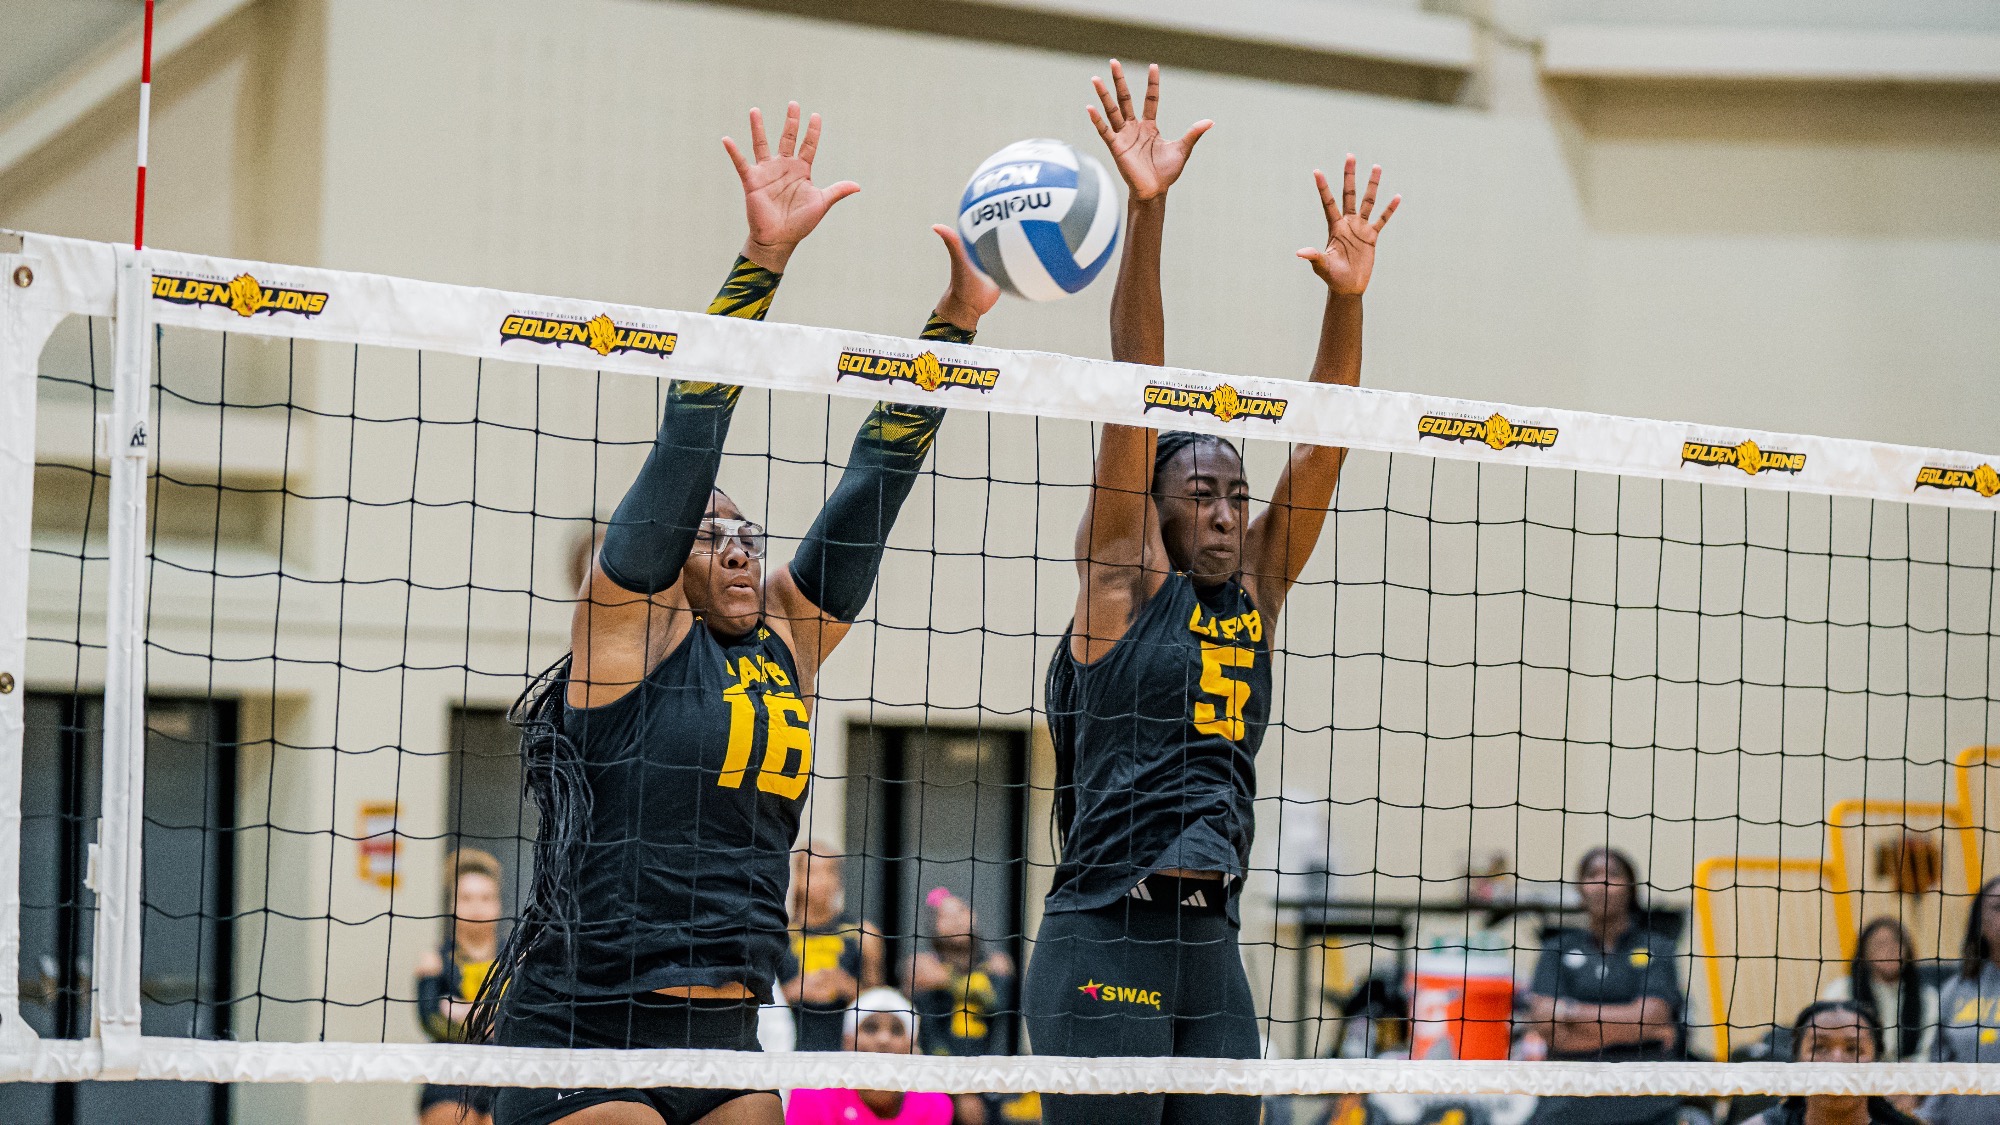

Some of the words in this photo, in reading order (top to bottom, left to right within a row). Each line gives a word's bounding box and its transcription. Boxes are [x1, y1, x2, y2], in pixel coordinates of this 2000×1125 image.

[970, 191, 1051, 226] molten
[261, 289, 328, 312] LIONS
[502, 316, 589, 342] GOLDEN
[614, 329, 678, 352] LIONS
[838, 353, 916, 379] GOLDEN
[940, 365, 1000, 387] LIONS
[1145, 386, 1214, 410] GOLDEN
[1238, 398, 1287, 417] LIONS
[1418, 416, 1487, 439] GOLDEN
[1511, 426, 1558, 445] LIONS
[1682, 443, 1737, 464] GOLDEN
[1761, 452, 1806, 470] LIONS
[1917, 468, 1976, 488] GOLDEN
[1194, 640, 1255, 741] 5
[717, 684, 812, 801] 16
[1101, 985, 1162, 1006] SWAC
